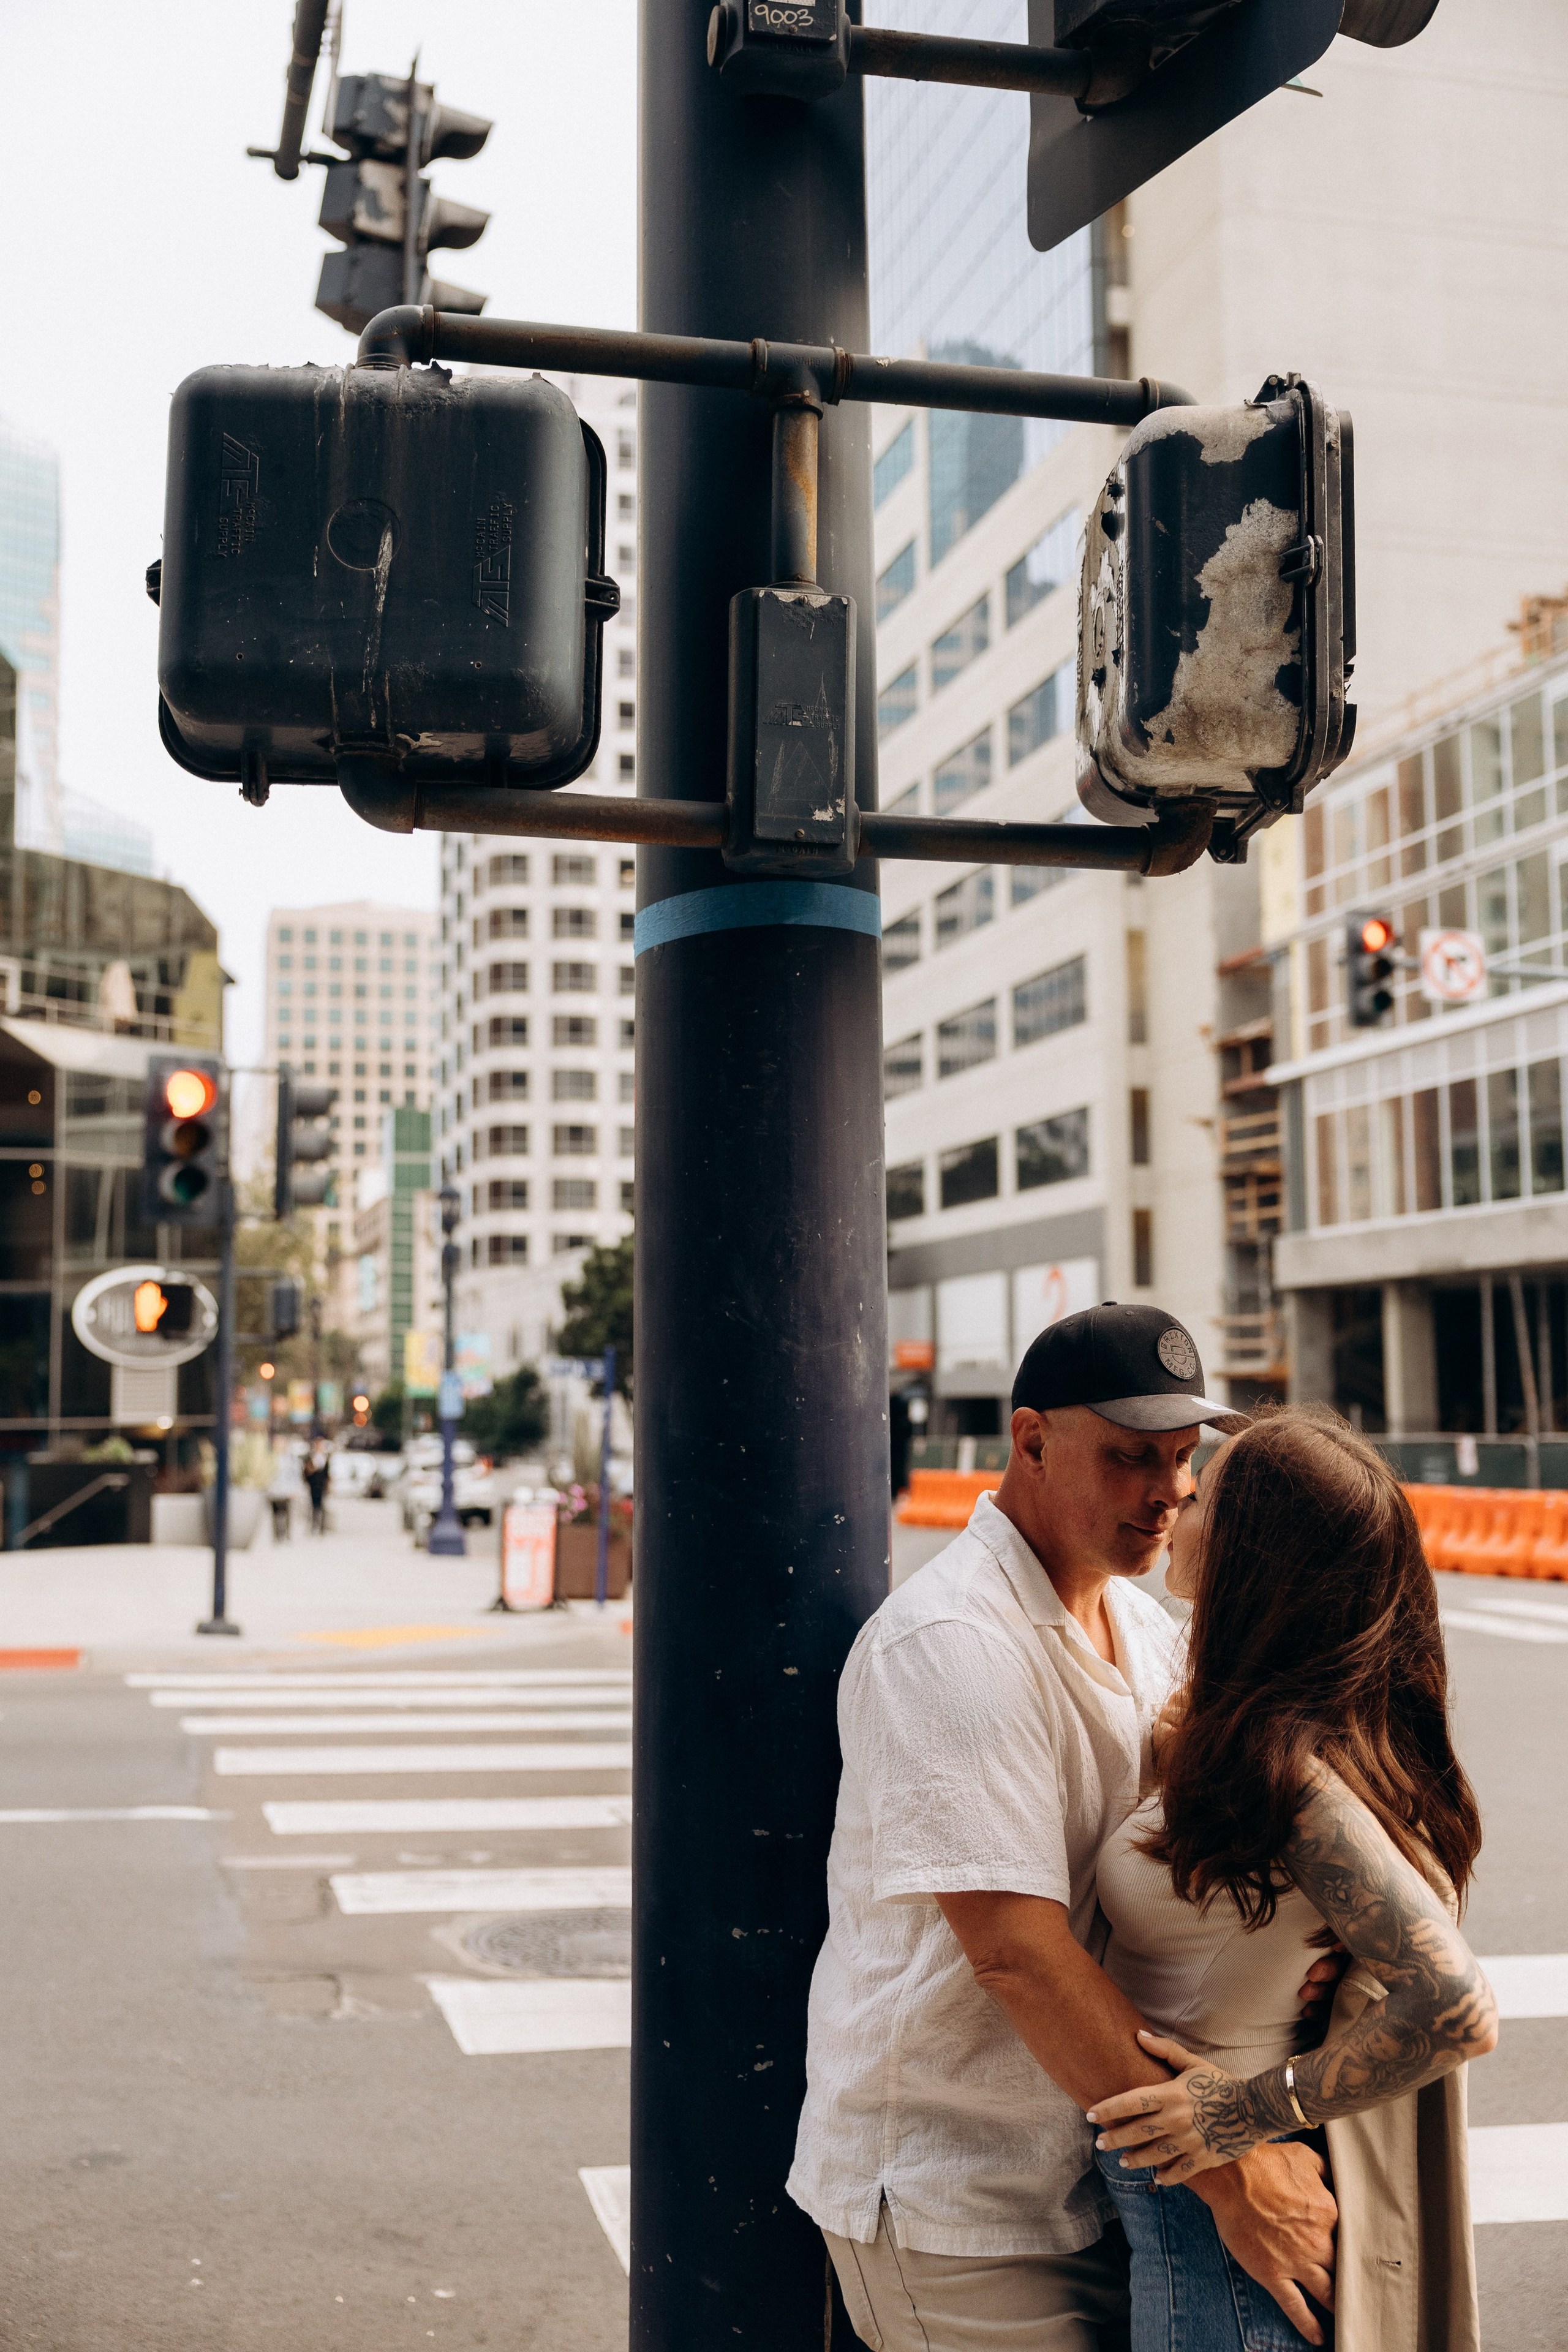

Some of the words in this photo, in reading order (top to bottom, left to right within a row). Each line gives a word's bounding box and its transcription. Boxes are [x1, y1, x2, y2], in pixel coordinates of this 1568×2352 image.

[755, 4, 814, 26] 9003
[217, 517, 228, 558] SUPPLY
[231, 508, 243, 555] TRAFFIC
[488, 505, 500, 551] TRAFFIC
[502, 502, 513, 542] SUPPLY
[810, 714, 840, 722] TRAFFIC
[1161, 1332, 1193, 1354] BRIXTON
